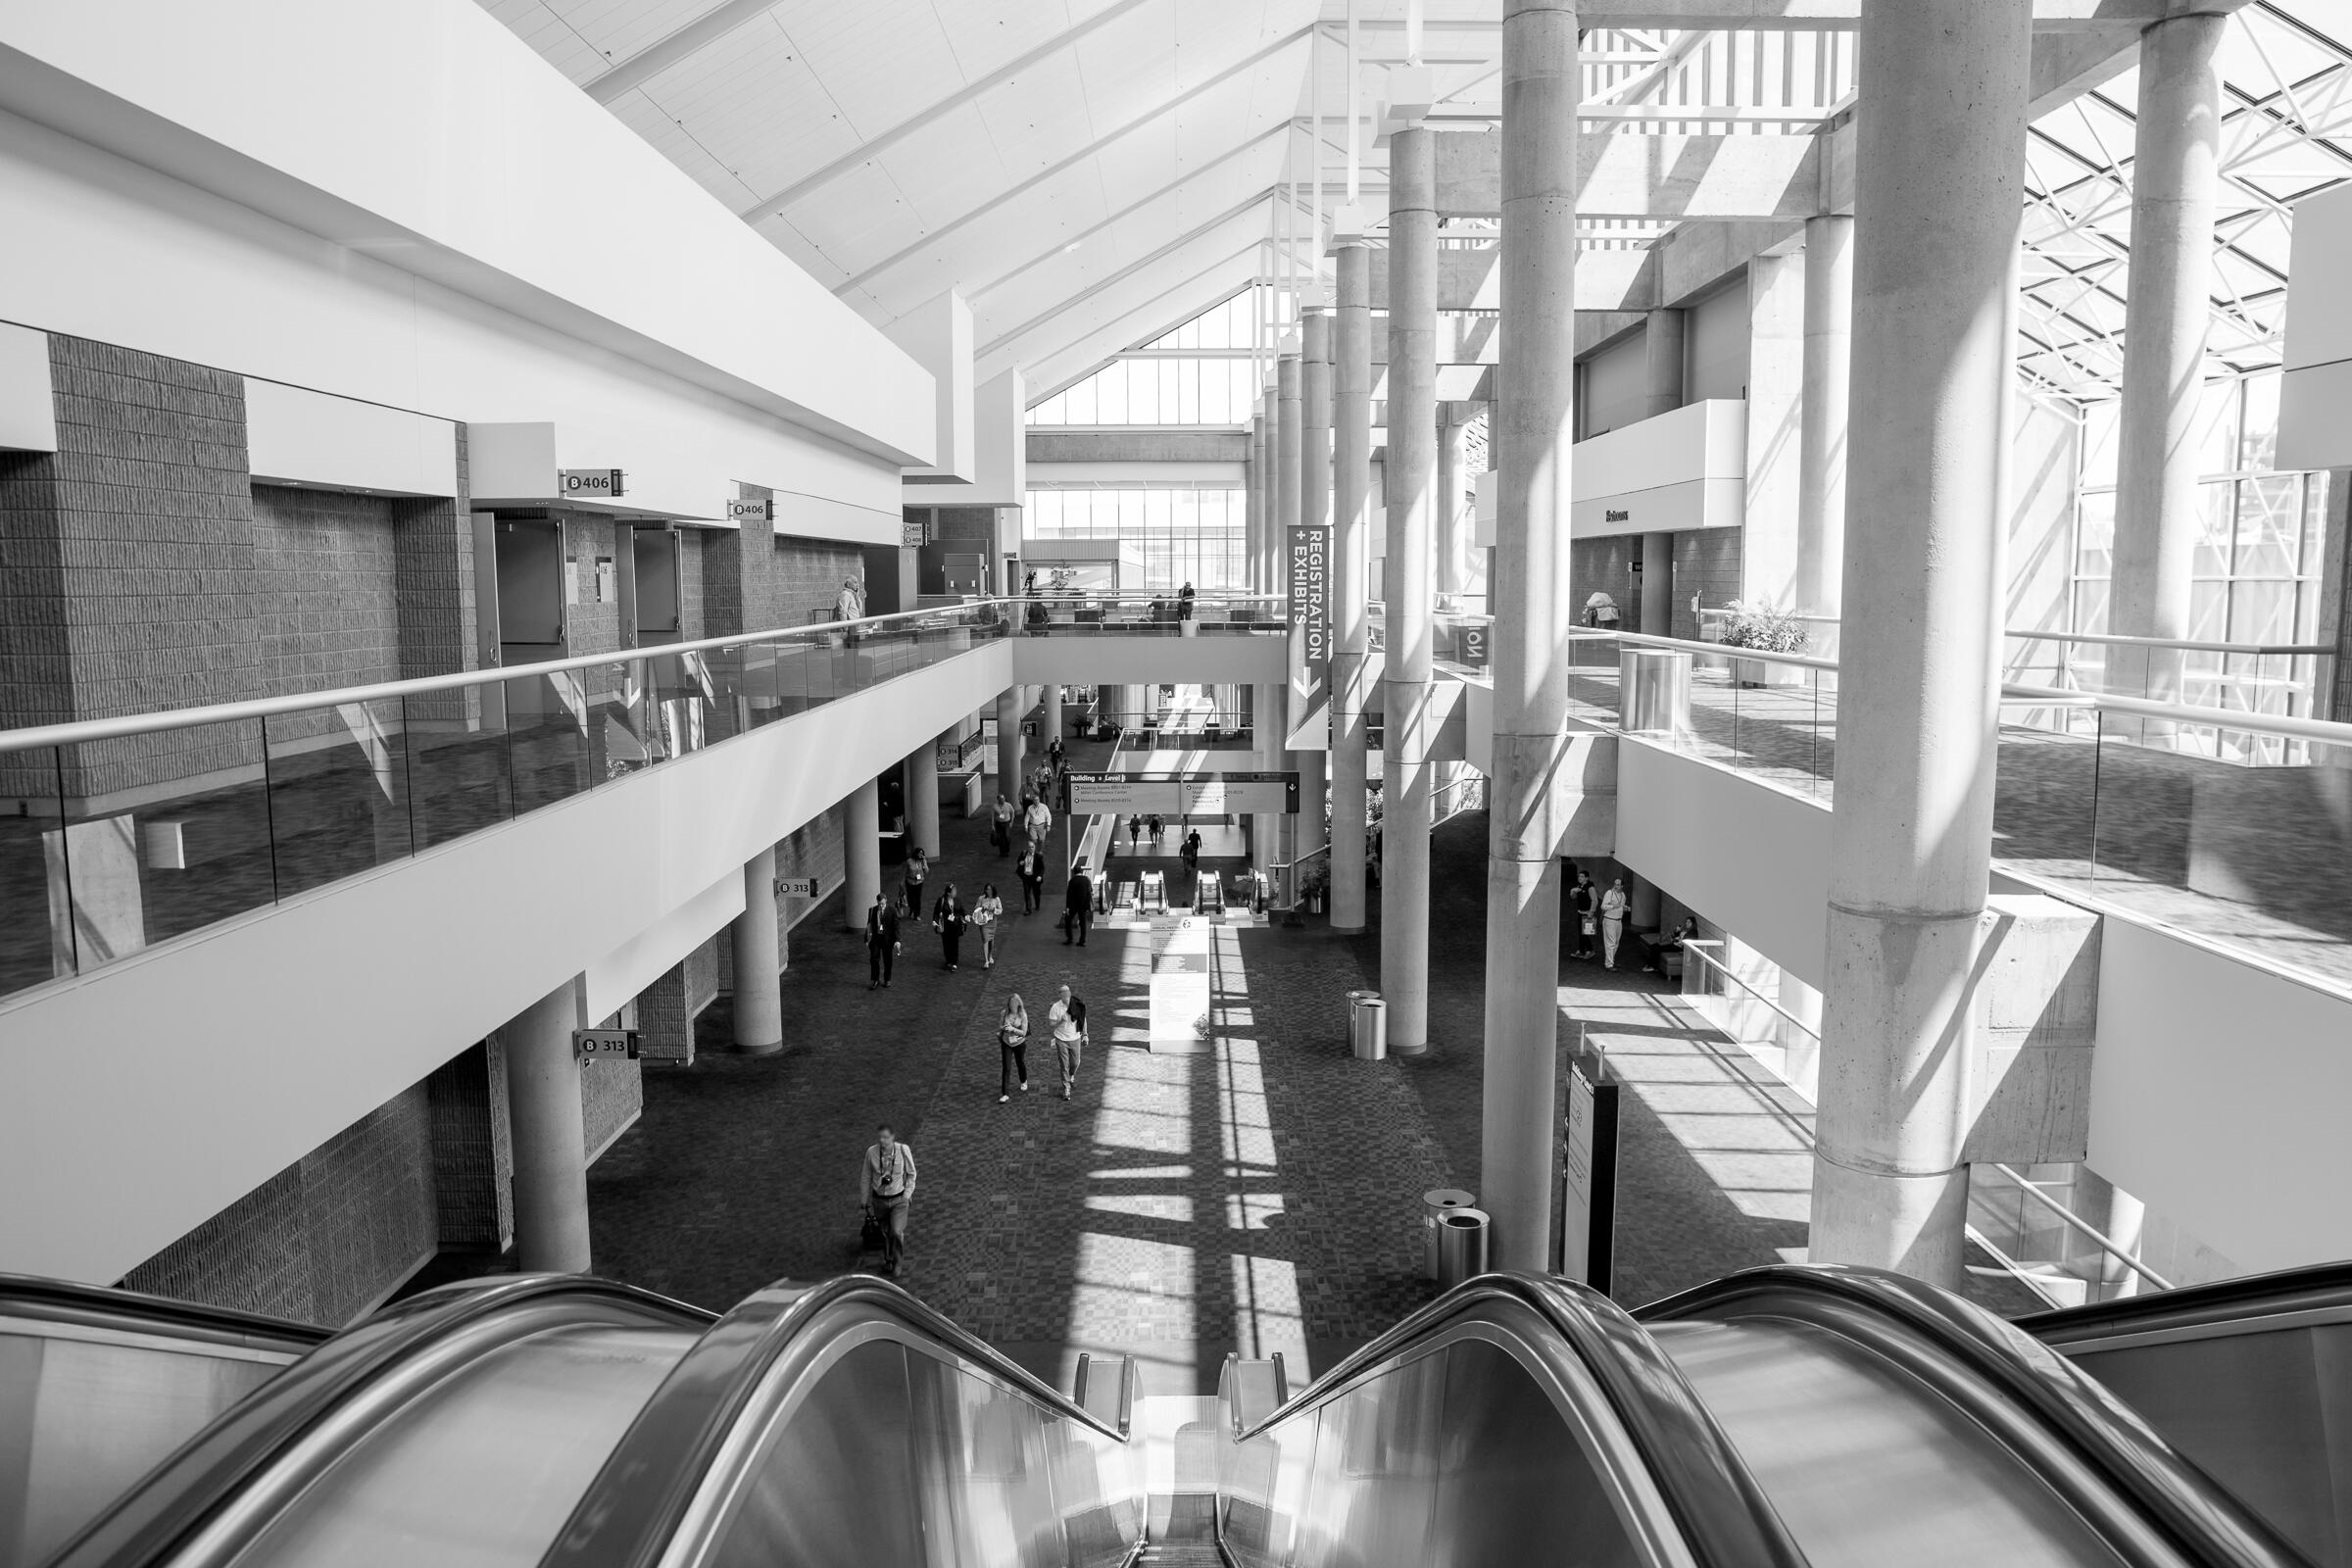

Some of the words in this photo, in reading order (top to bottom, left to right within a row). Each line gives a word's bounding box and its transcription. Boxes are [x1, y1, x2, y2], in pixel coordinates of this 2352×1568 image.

[583, 477, 609, 489] 406
[745, 505, 763, 514] 406
[1294, 546, 1307, 625] EXHIBITS
[1309, 530, 1323, 660] REGISTRATION
[793, 883, 808, 893] 313
[603, 1040, 625, 1052] 313
